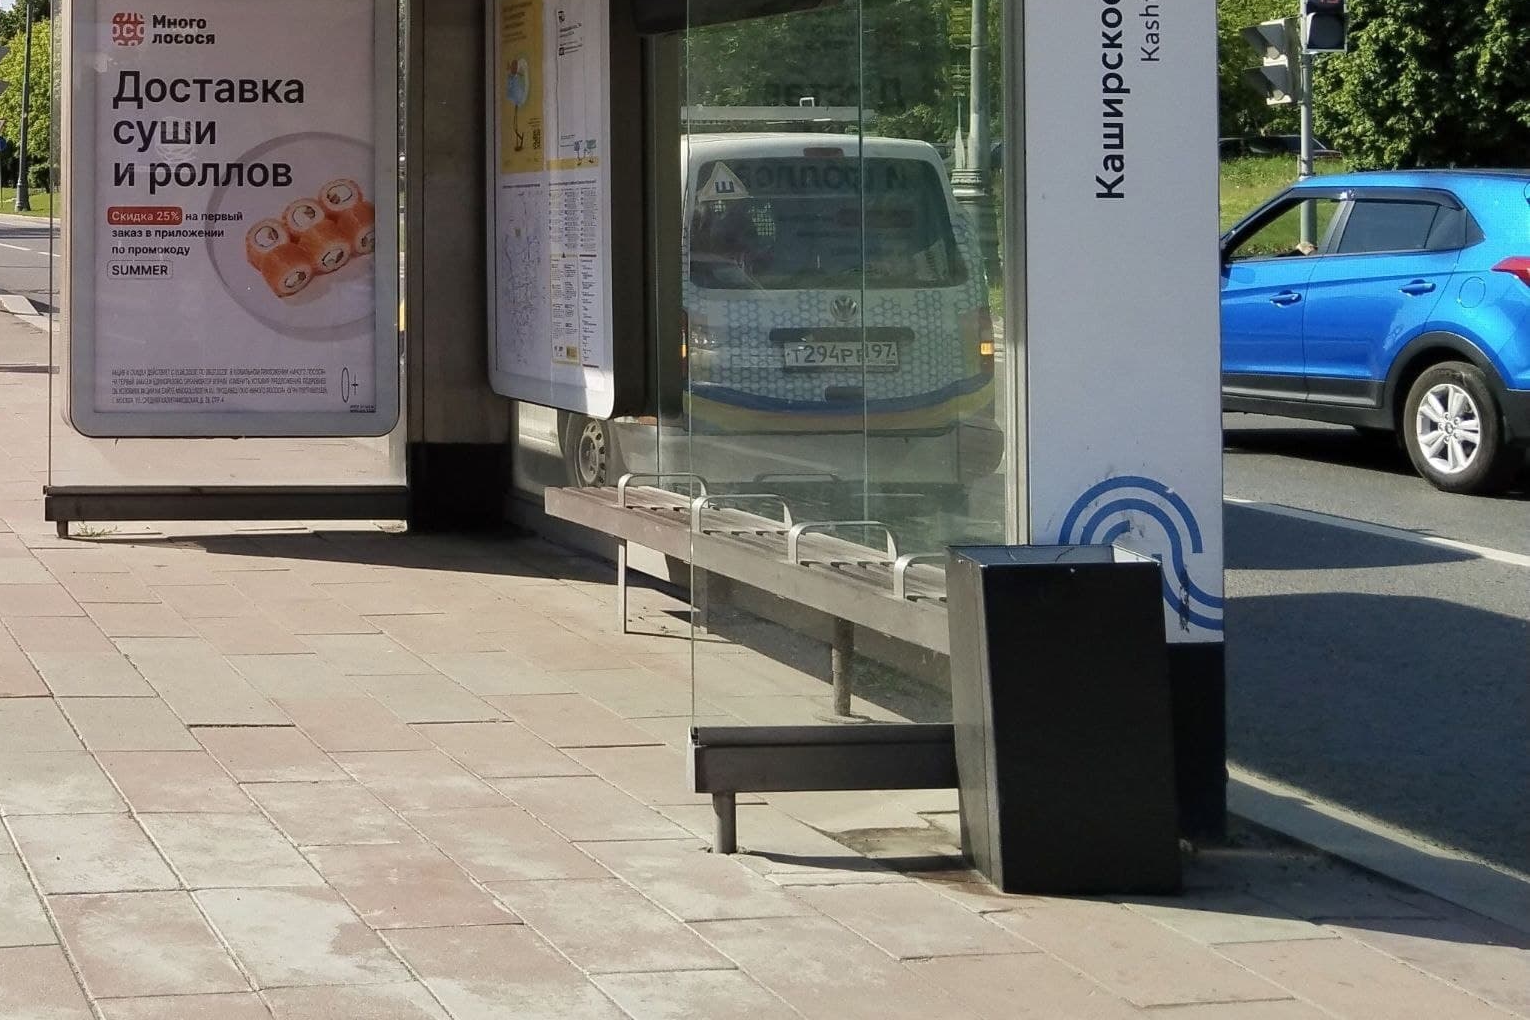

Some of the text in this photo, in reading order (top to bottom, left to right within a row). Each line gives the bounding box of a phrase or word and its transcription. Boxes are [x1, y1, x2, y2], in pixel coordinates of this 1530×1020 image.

[152, 14, 207, 29] Много
[151, 33, 215, 45] лосося
[112, 70, 305, 109] Доставка
[113, 120, 216, 153] суши
[113, 161, 293, 195] и роллов
[111, 211, 243, 223] Скидка 25% на первый
[111, 229, 143, 238] заказ
[154, 229, 225, 240] приложении
[111, 246, 190, 256] по промокоду
[111, 265, 168, 276] SUMMER
